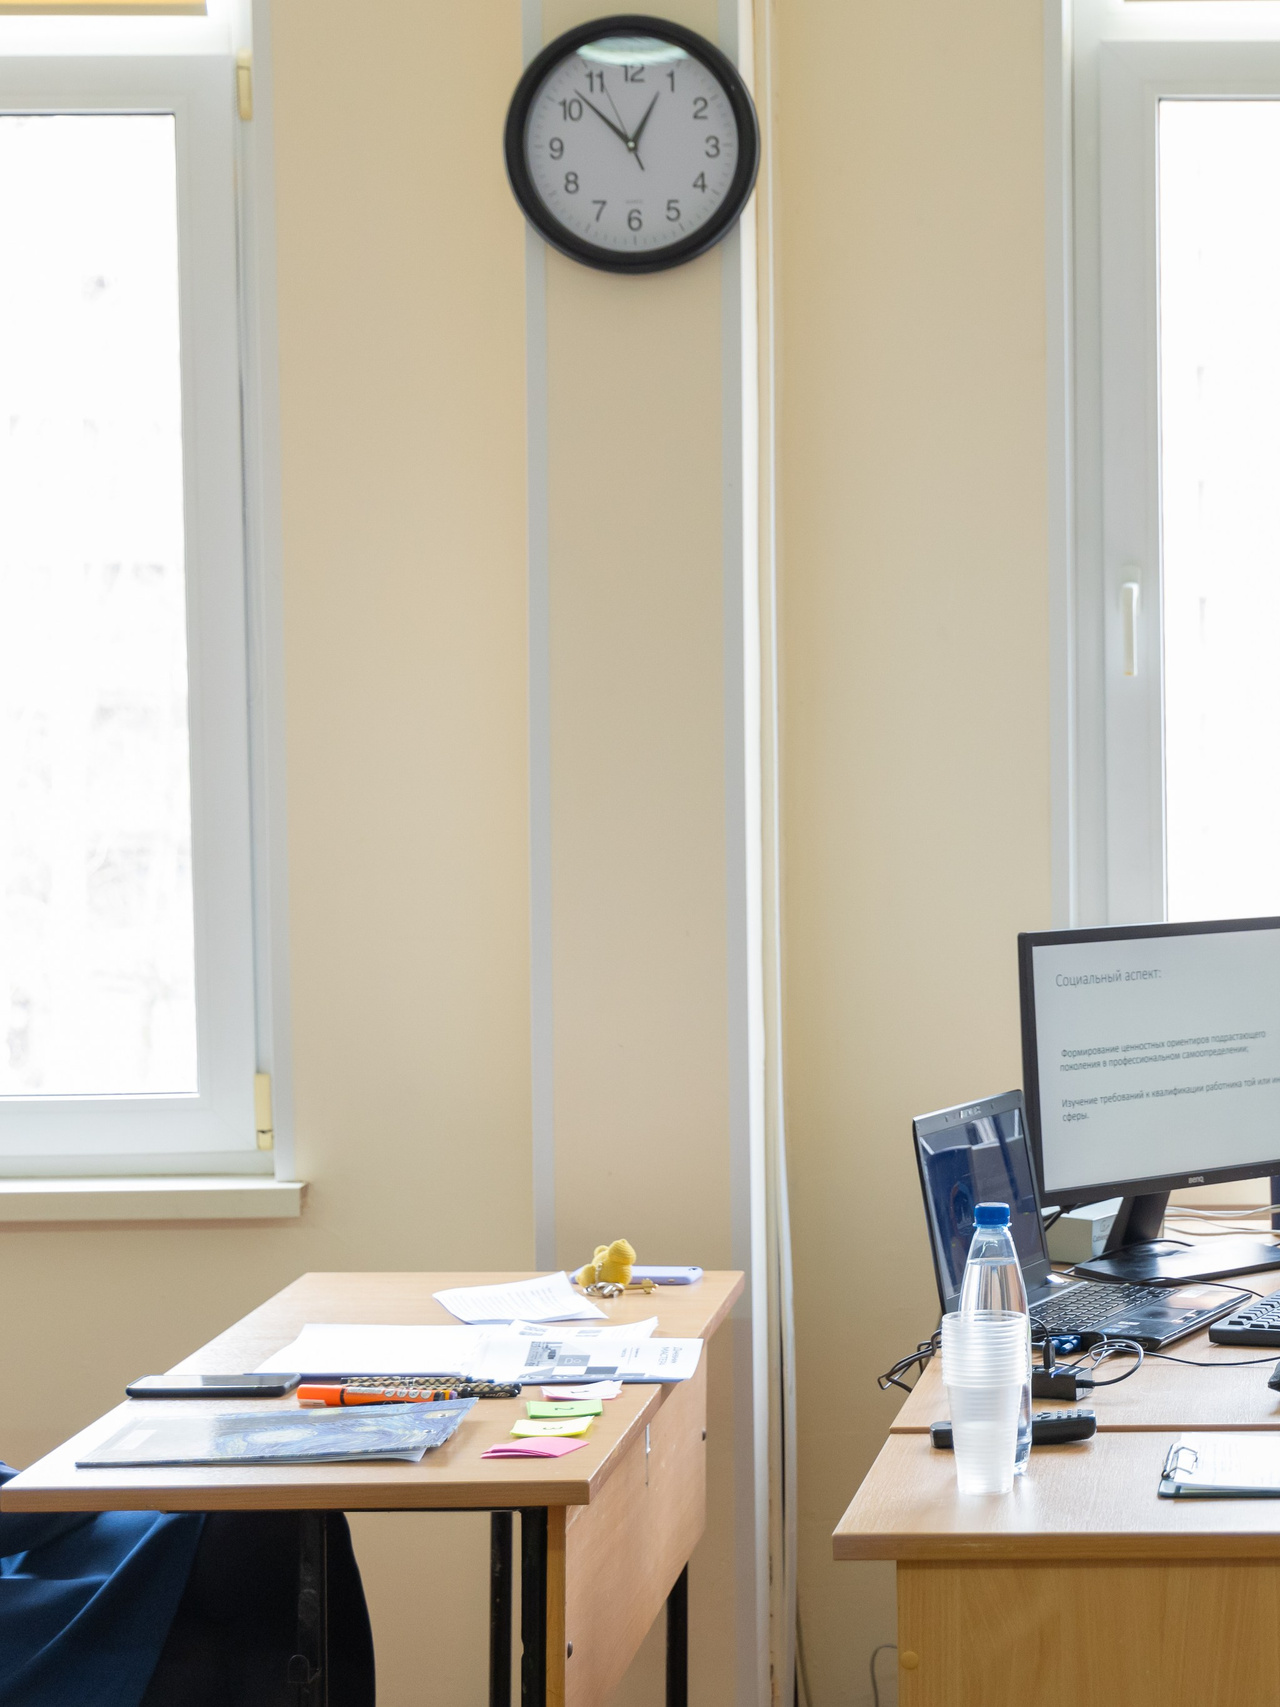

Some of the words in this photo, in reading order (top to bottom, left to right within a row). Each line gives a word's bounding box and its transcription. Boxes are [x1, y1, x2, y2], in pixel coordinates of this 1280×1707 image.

[585, 72, 605, 93] 11
[620, 62, 645, 82] 12
[666, 72, 675, 92] 1
[559, 99, 583, 121] 10
[693, 97, 708, 120] 2
[549, 137, 564, 160] 9
[705, 136, 720, 158] 3
[564, 172, 579, 194] 8
[693, 172, 708, 193] 4
[592, 201, 607, 222] 7
[627, 209, 642, 232] 6
[666, 199, 681, 221] 5
[1056, 970, 1122, 988] Социальный
[1125, 969, 1162, 982] аспект:
[1061, 1046, 1120, 1058] Формирование
[1121, 1041, 1165, 1052] ценностных
[1166, 1036, 1210, 1048] ориентиров
[1211, 1030, 1266, 1043] подрастающего
[1060, 1060, 1101, 1071] поколения
[1109, 1052, 1180, 1068] профессиональном
[1061, 1096, 1098, 1109] Изучение
[1100, 1090, 1144, 1105] требований
[1151, 1086, 1204, 1098] квалификации
[1206, 1081, 1243, 1093] работника
[1244, 1077, 1256, 1087] той
[1257, 1077, 1270, 1085] или
[1062, 1112, 1089, 1123] сферы.
[1188, 1176, 1205, 1184] BenQ
